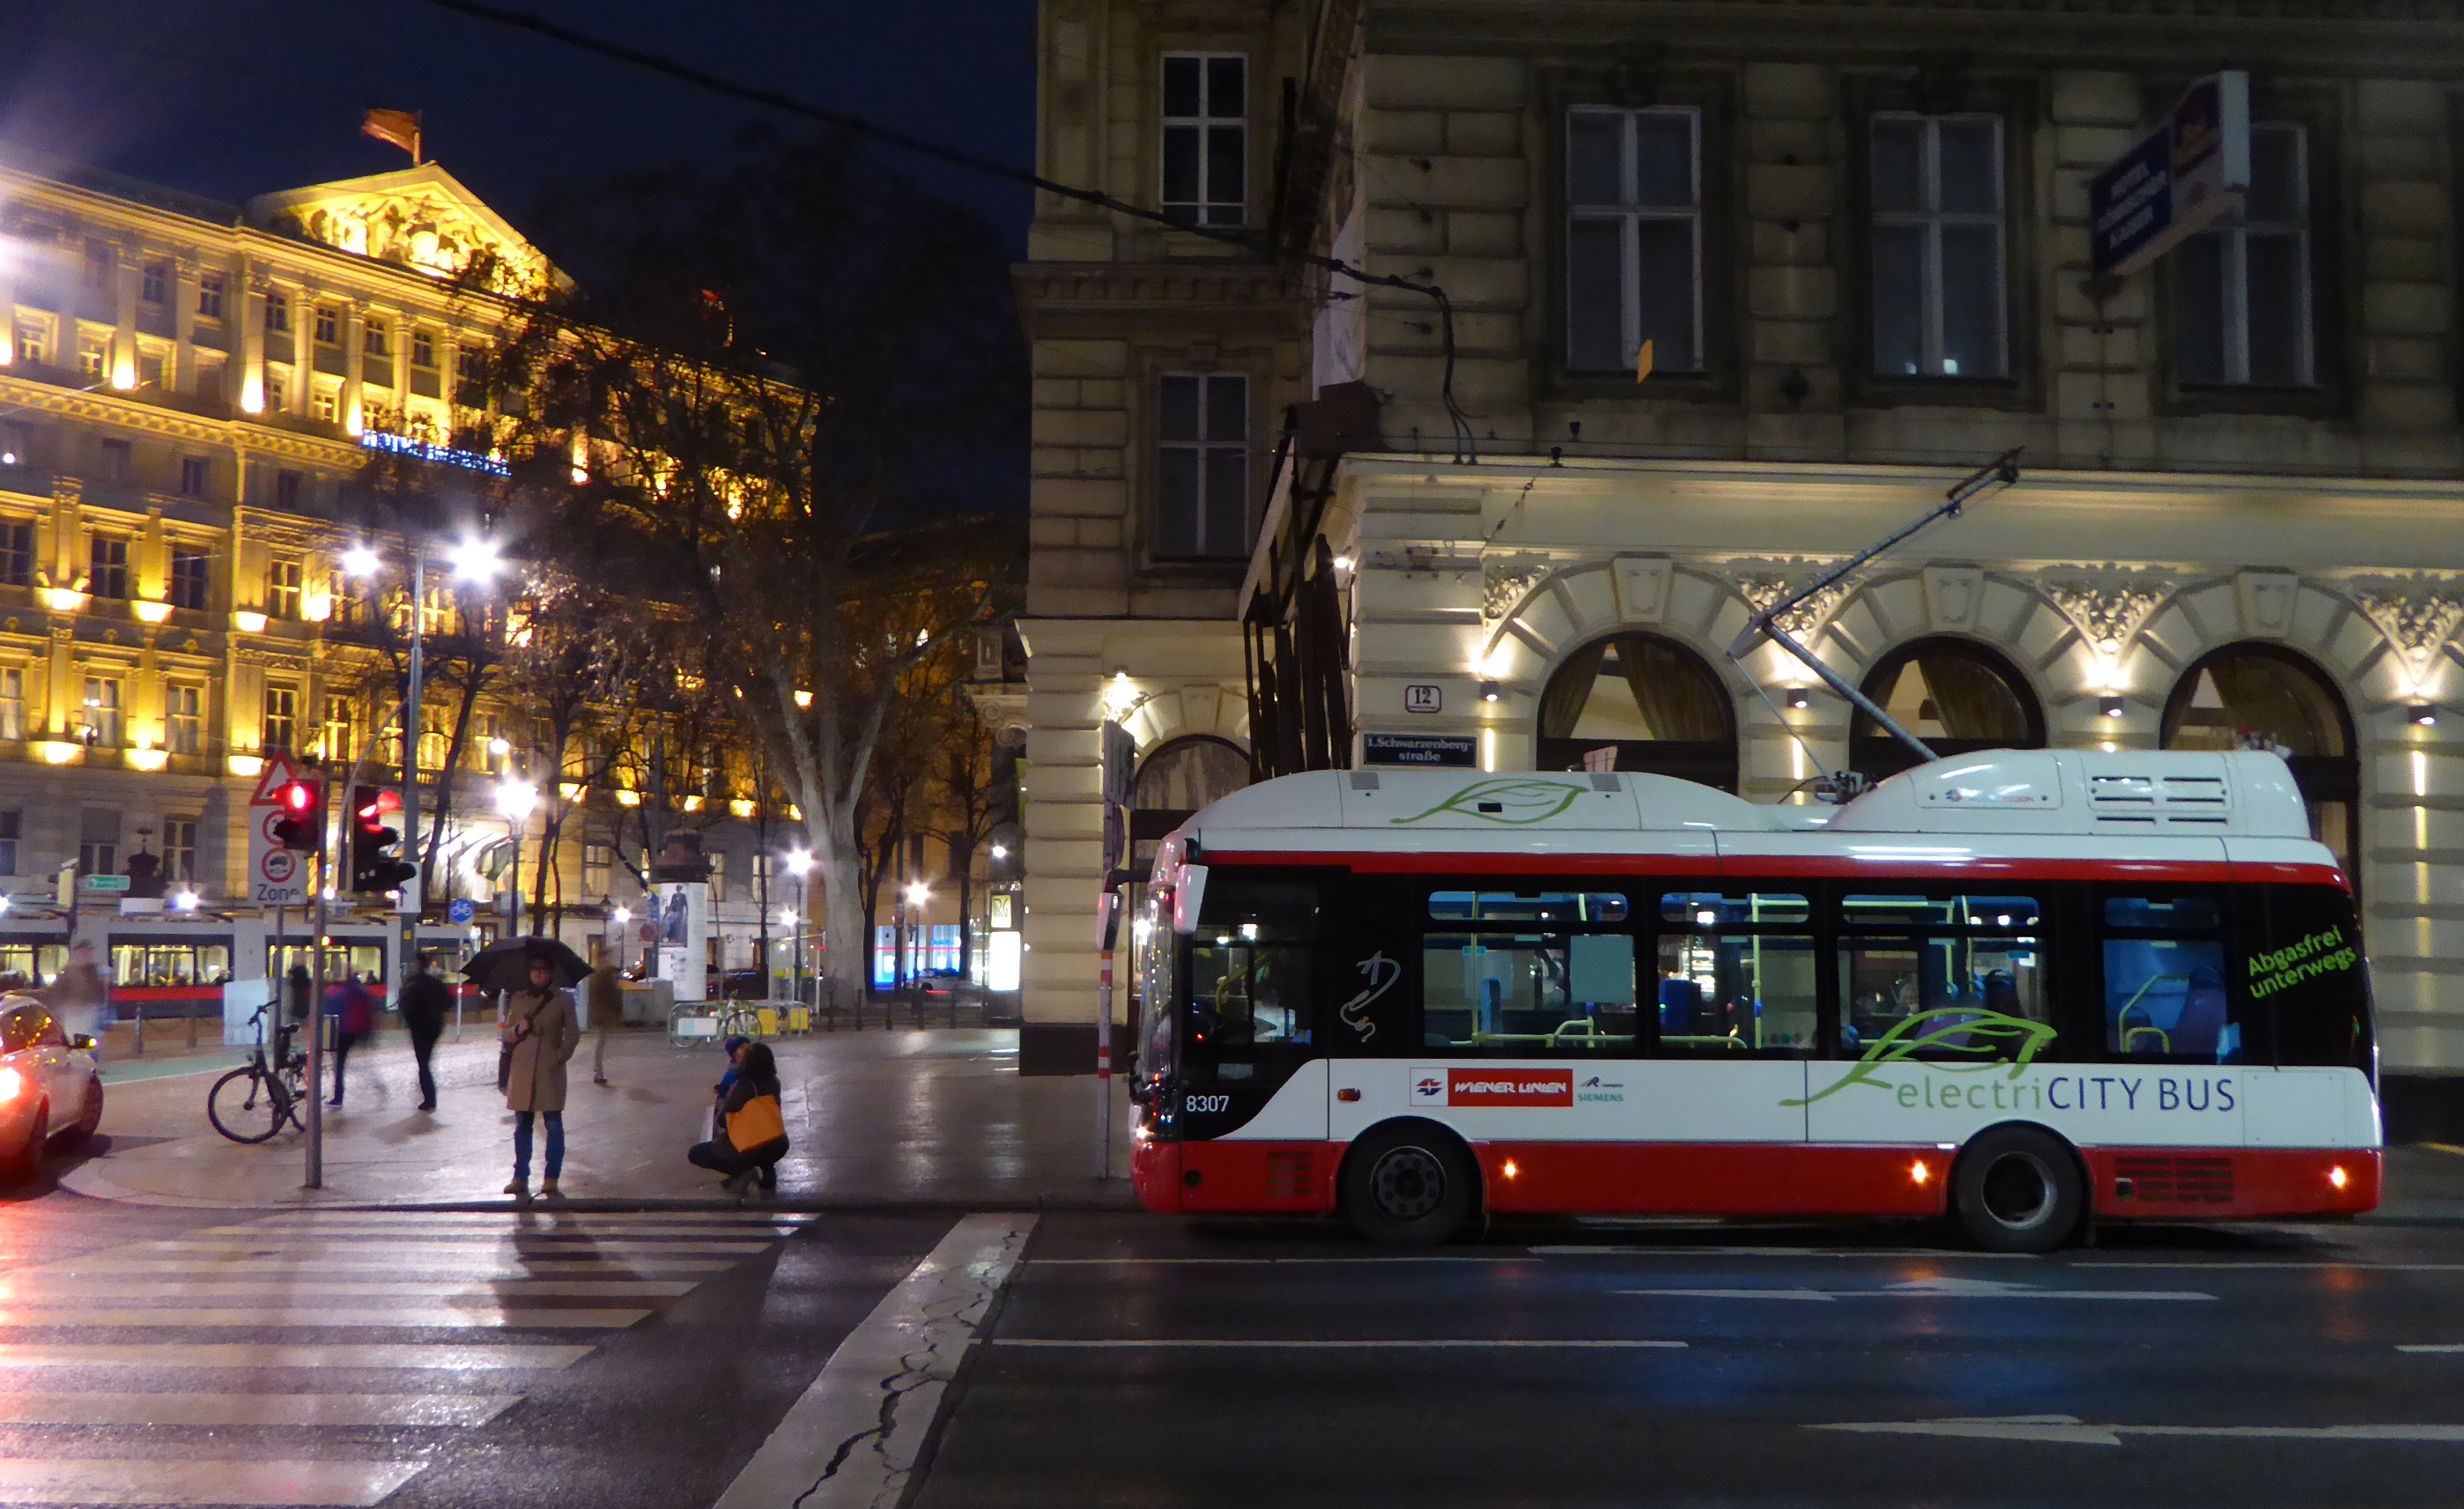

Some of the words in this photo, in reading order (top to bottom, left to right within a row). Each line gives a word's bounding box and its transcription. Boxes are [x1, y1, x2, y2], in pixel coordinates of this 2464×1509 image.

[1415, 687, 1432, 704] 12
[1398, 750, 1441, 762] straße
[257, 884, 300, 901] Zone
[2248, 923, 2343, 977] Abgasfrei
[2249, 946, 2357, 999] unterwegs
[1454, 1081, 1515, 1094] WIENER
[1519, 1081, 1566, 1094] LINIEN
[1896, 1075, 2142, 1111] electriCITY
[2158, 1077, 2236, 1112] BUS
[1186, 1095, 1230, 1113] 8307
[1577, 1093, 1624, 1102] SIEMENS
